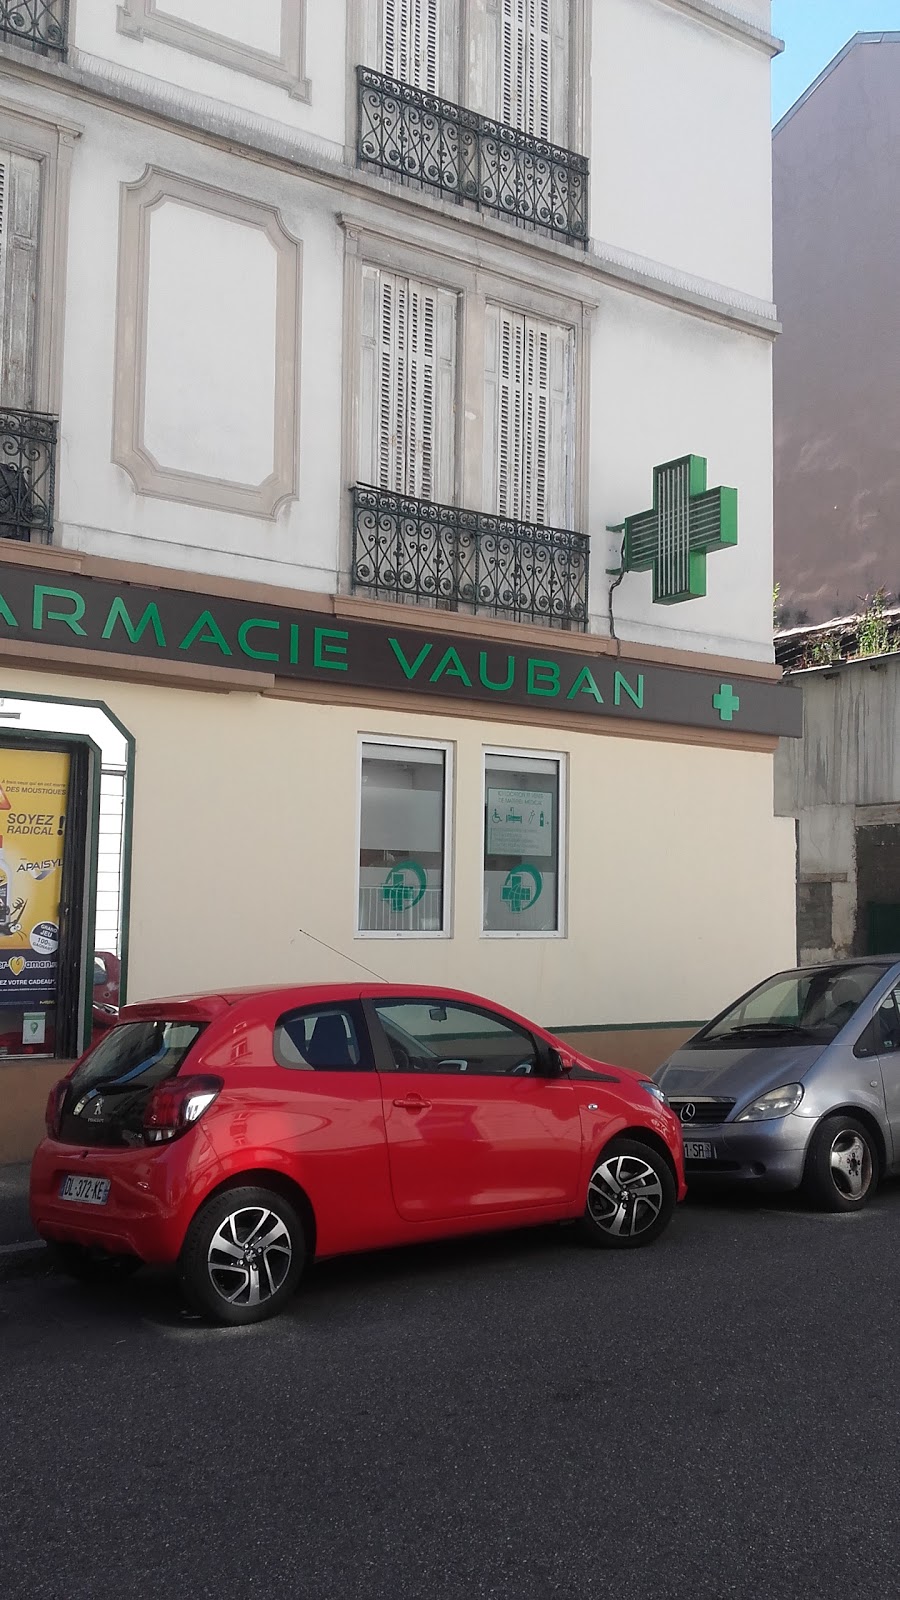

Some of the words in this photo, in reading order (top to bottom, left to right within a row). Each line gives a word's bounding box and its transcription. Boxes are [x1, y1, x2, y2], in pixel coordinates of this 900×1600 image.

[388, 637, 645, 709] VAUBAN
[21, 787, 66, 795] MOUSTIQUES
[7, 813, 54, 826] SOYEZ
[6, 826, 54, 836] RADICAL
[16, 858, 64, 872] APAISYL
[40, 924, 57, 933] GRAND
[64, 1177, 104, 1200] DL-372-KE
